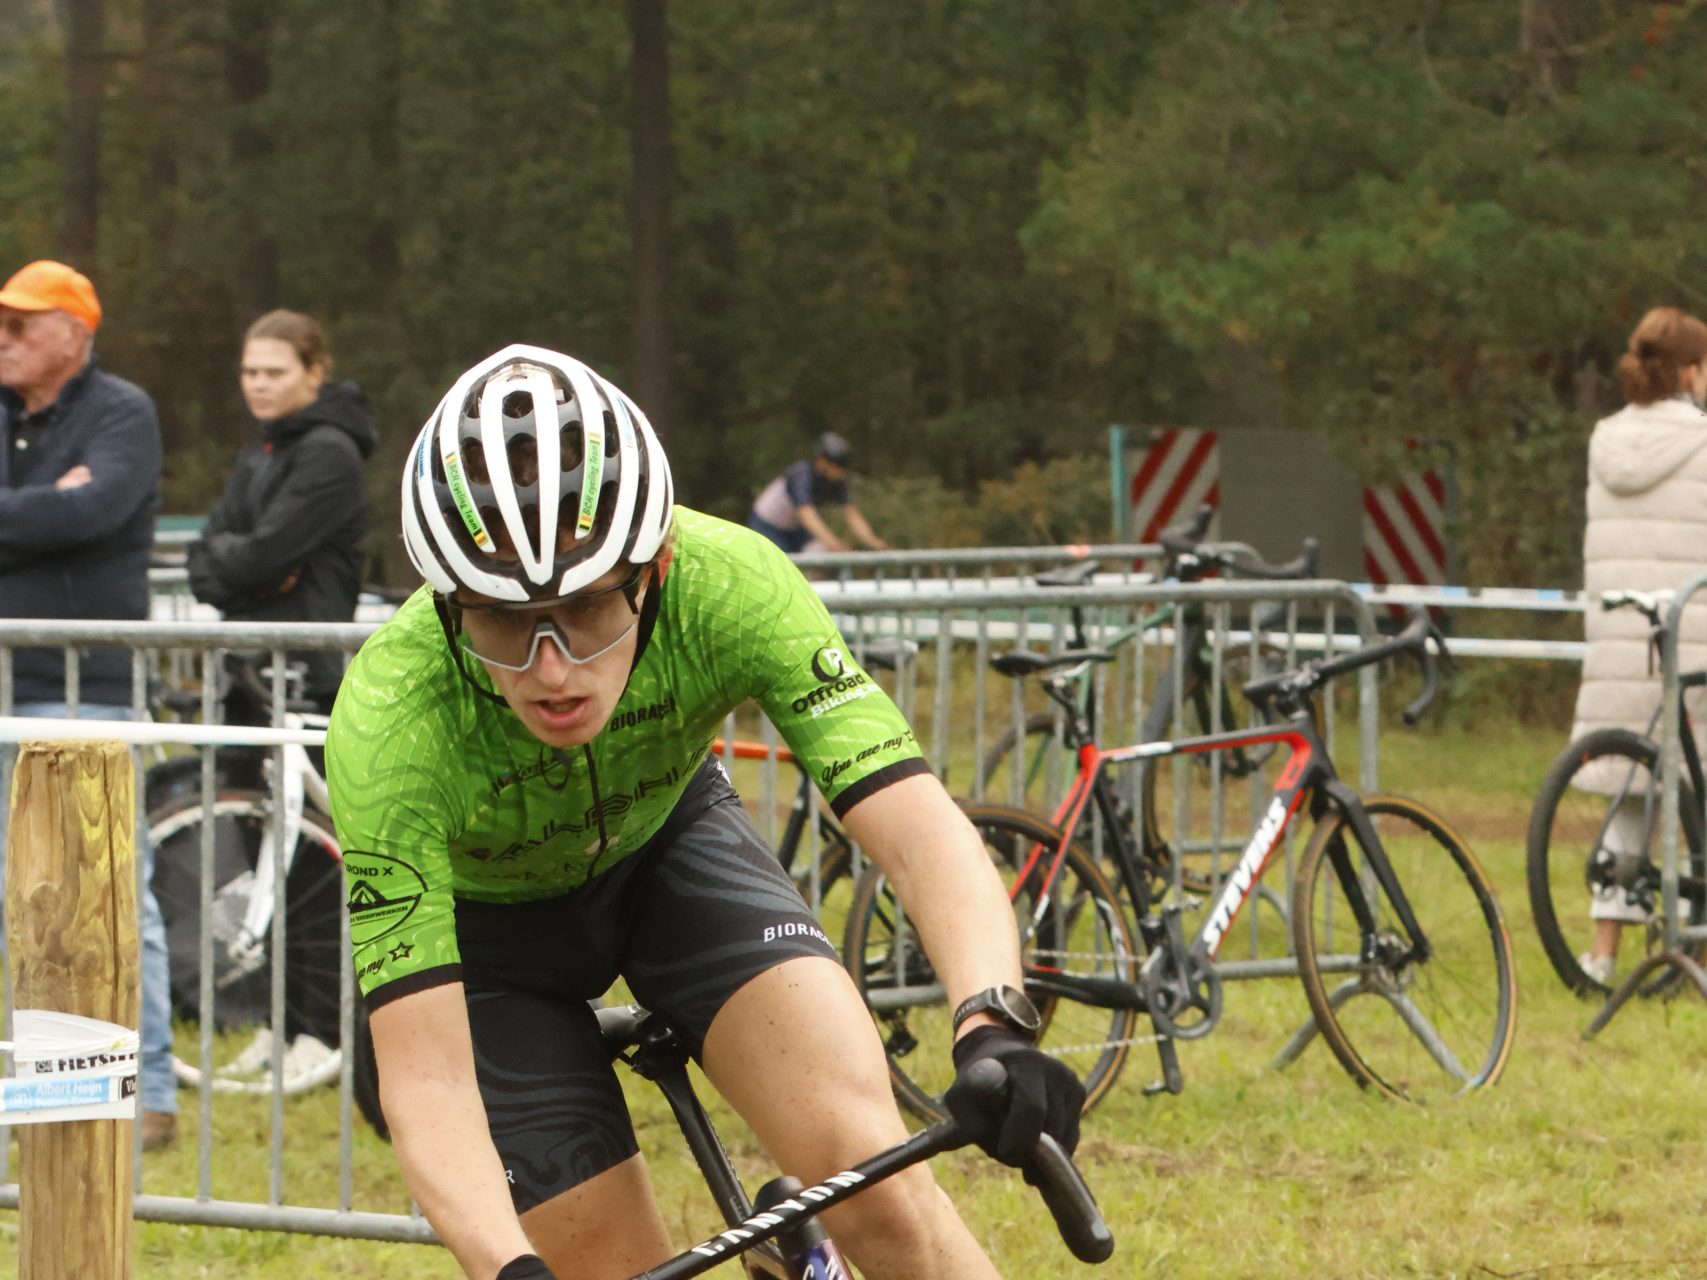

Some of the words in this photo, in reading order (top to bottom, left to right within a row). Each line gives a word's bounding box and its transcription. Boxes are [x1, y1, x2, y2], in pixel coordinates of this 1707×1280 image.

[464, 508, 478, 530] Team
[821, 758, 852, 791] You
[882, 736, 903, 751] my
[345, 864, 379, 877] ROND
[691, 1170, 867, 1257] CANYON
